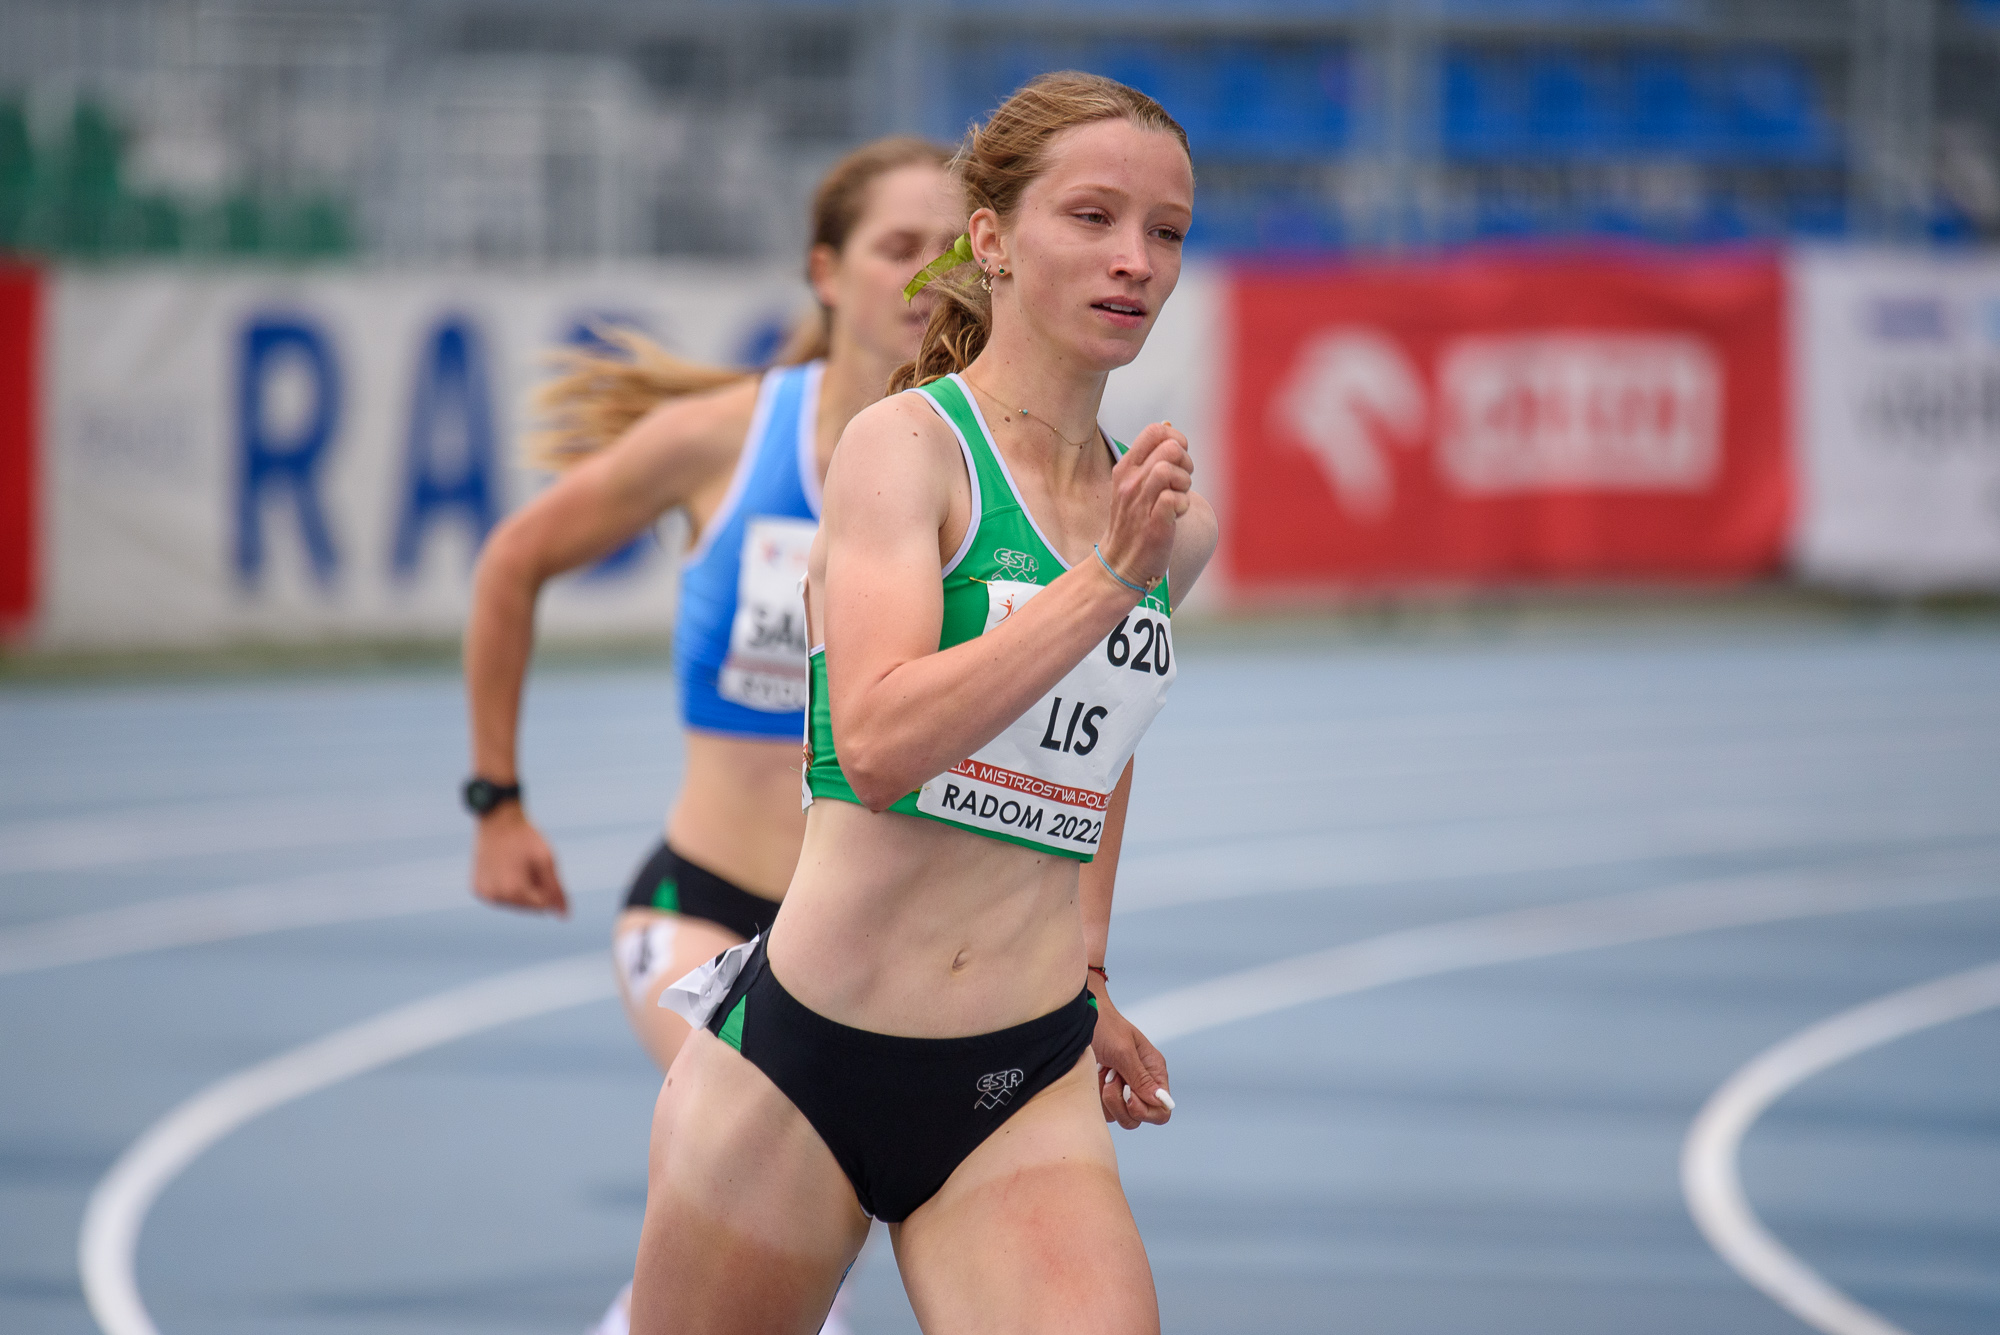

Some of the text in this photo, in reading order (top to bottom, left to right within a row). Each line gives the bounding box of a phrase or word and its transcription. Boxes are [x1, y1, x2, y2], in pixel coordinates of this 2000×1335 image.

[1107, 615, 1170, 677] 620
[1039, 696, 1108, 757] LIS
[941, 783, 1102, 845] RADOM 2022
[979, 766, 1076, 804] MISTRZOSTWA
